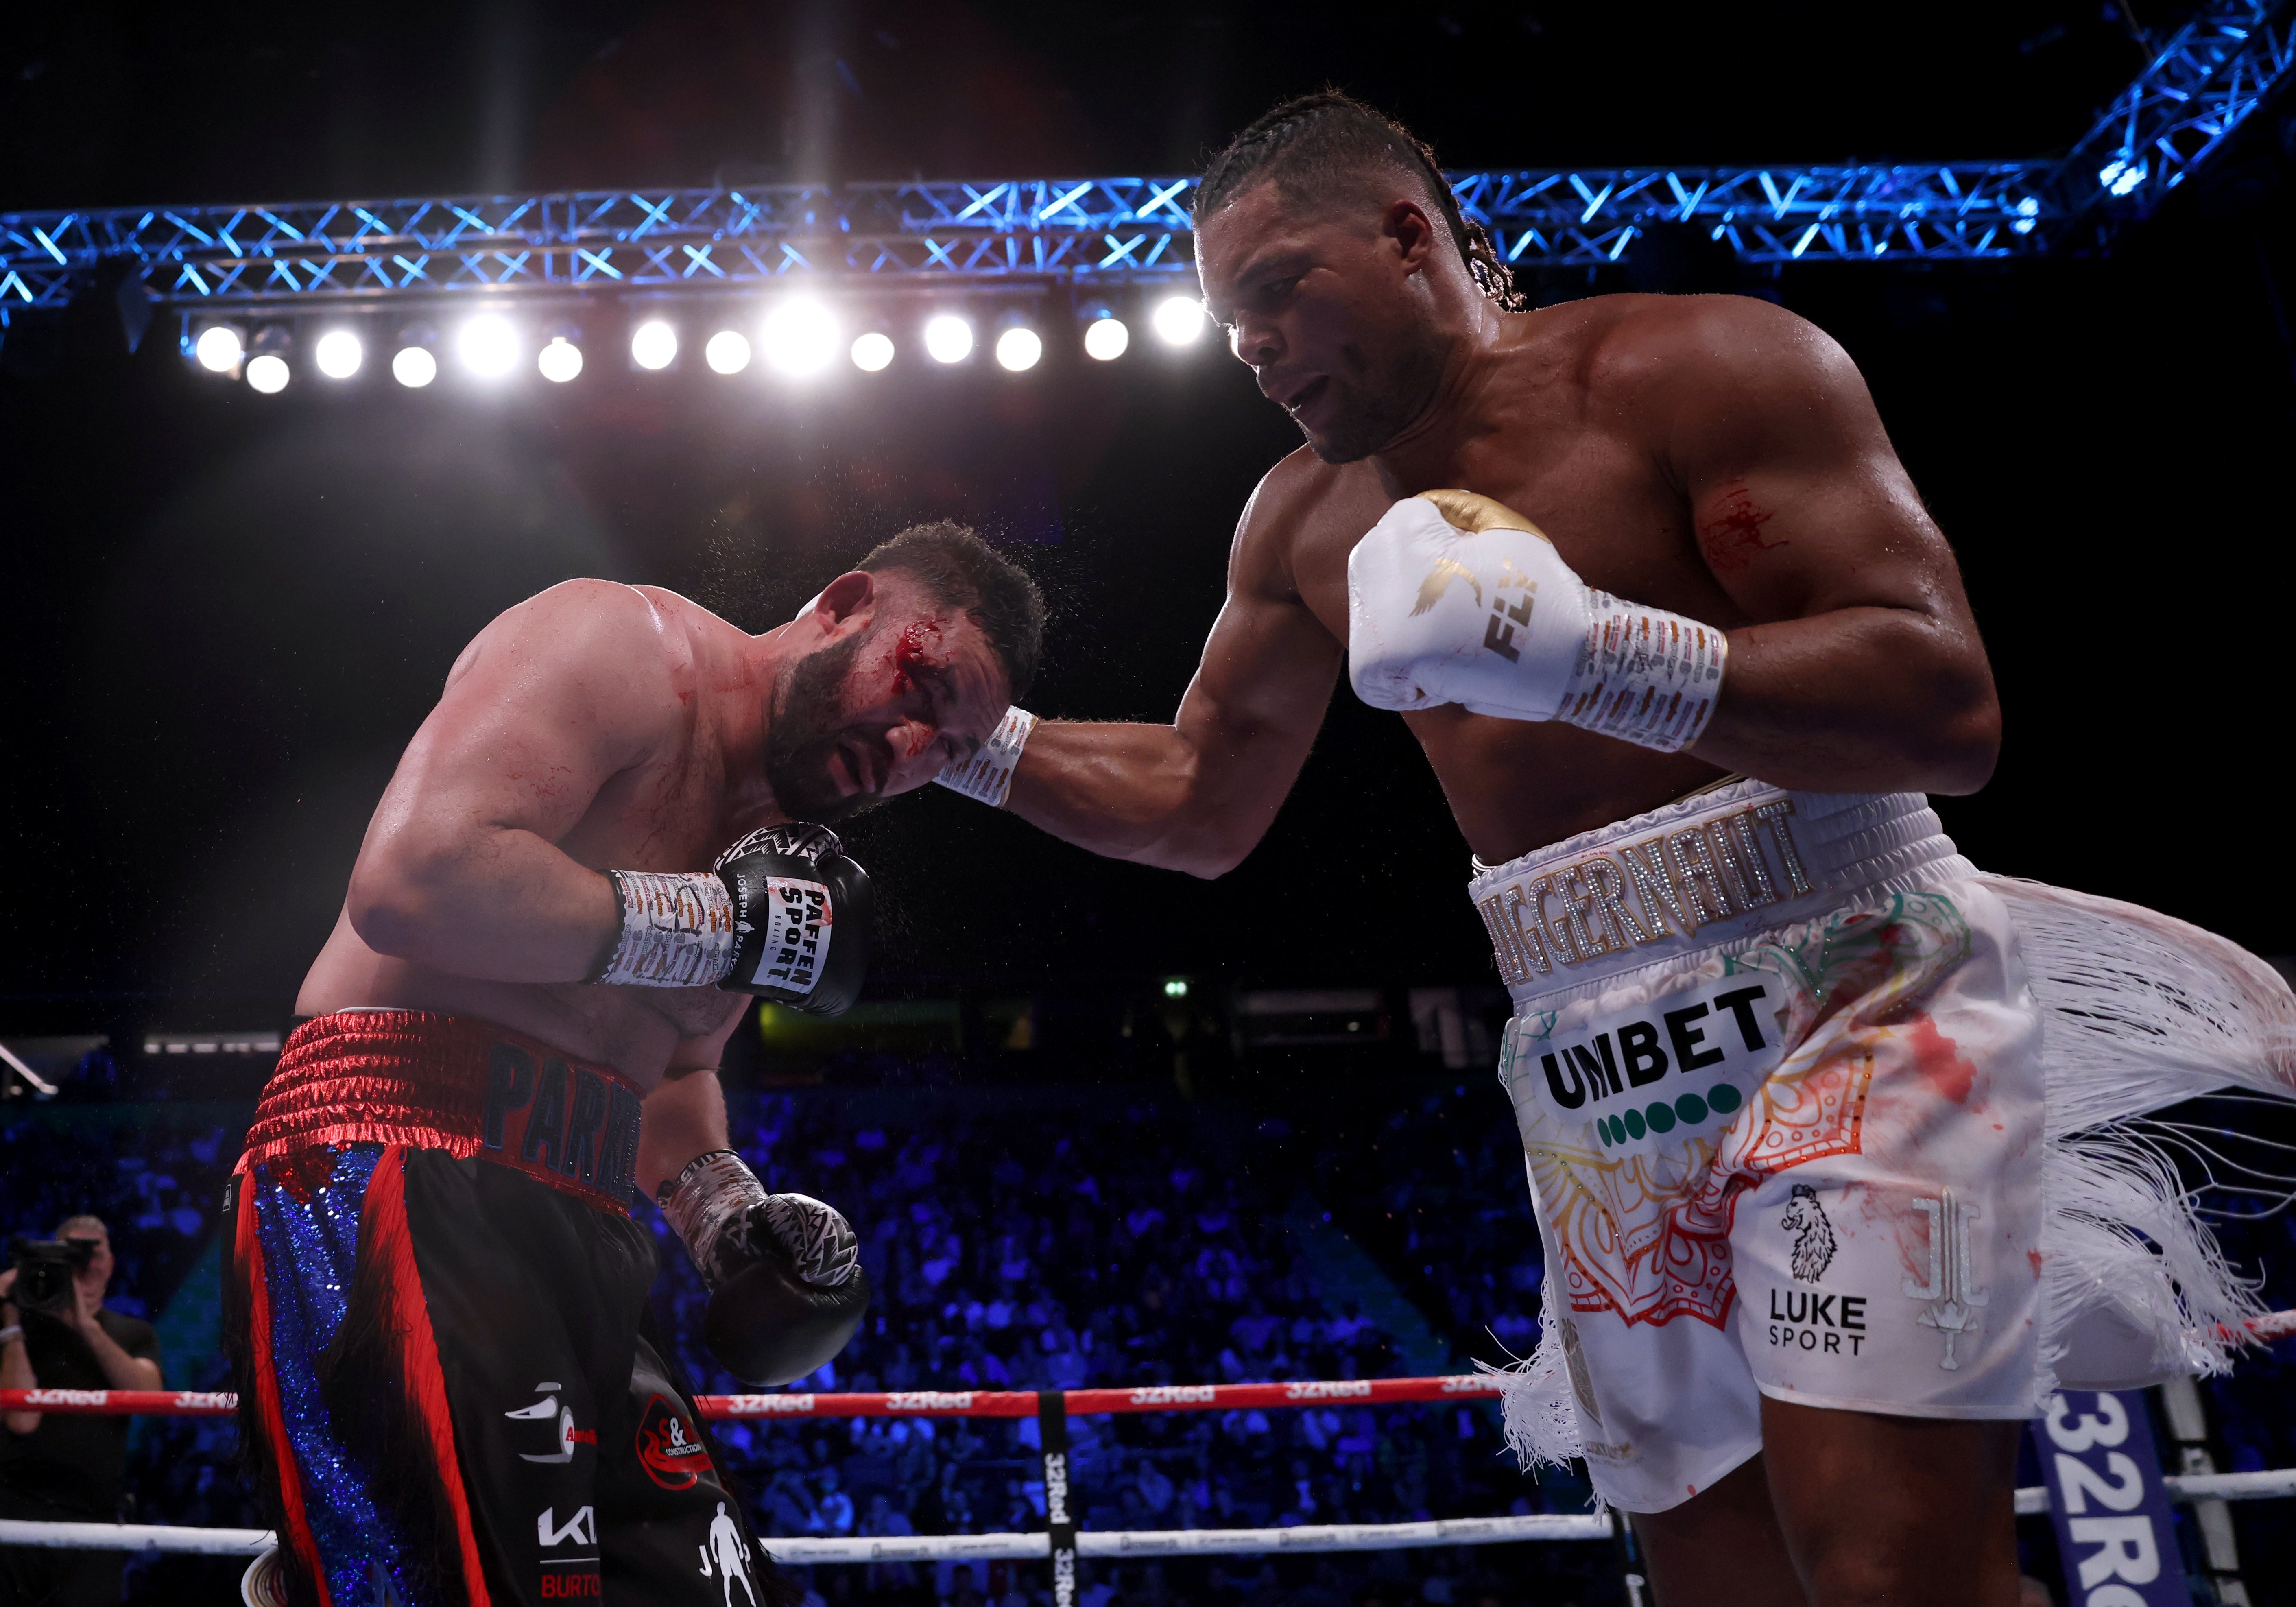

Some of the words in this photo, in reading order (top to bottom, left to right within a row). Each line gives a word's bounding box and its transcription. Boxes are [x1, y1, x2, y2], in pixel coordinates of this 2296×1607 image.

[737, 873, 748, 918] JOSEPH
[768, 887, 803, 981] SPORT
[770, 915, 782, 951] BOXING
[790, 889, 825, 986] PAFFEN
[1540, 985, 1766, 1109] UNIBET
[1770, 1288, 1866, 1330] LUKE
[1770, 1325, 1865, 1356] SPORT
[24, 1389, 107, 1406] 32Red
[728, 1394, 814, 1413] 32Red
[886, 1391, 972, 1410] 32Red
[1130, 1386, 1215, 1404] 32Red
[1286, 1379, 1371, 1398] 32Red
[666, 1443, 701, 1456] CONSTRUCTION
[1045, 1453, 1071, 1524] 32Red
[1054, 1548, 1075, 1607] 32Re
